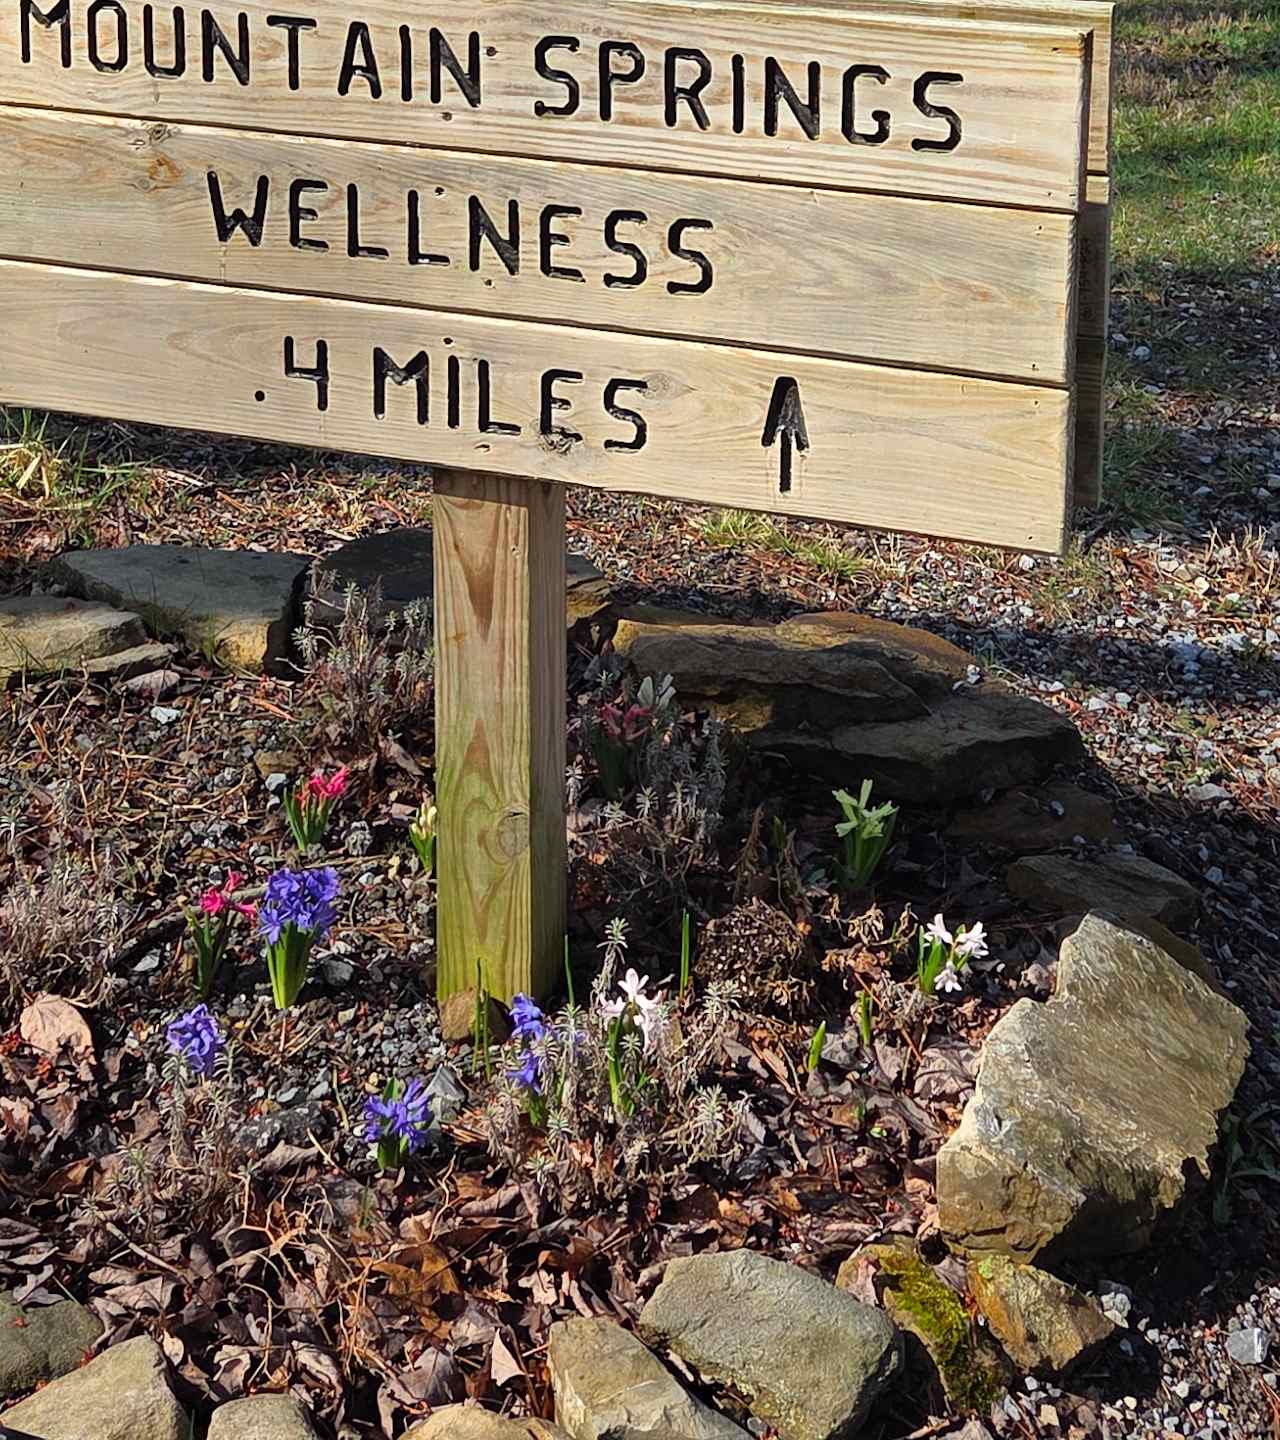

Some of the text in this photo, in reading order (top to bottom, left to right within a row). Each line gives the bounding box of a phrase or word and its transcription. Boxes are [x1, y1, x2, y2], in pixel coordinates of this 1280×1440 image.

[533, 34, 965, 153] SPRINGS
[206, 170, 714, 296] WELLNESS
[252, 335, 649, 452] .4 MILES
